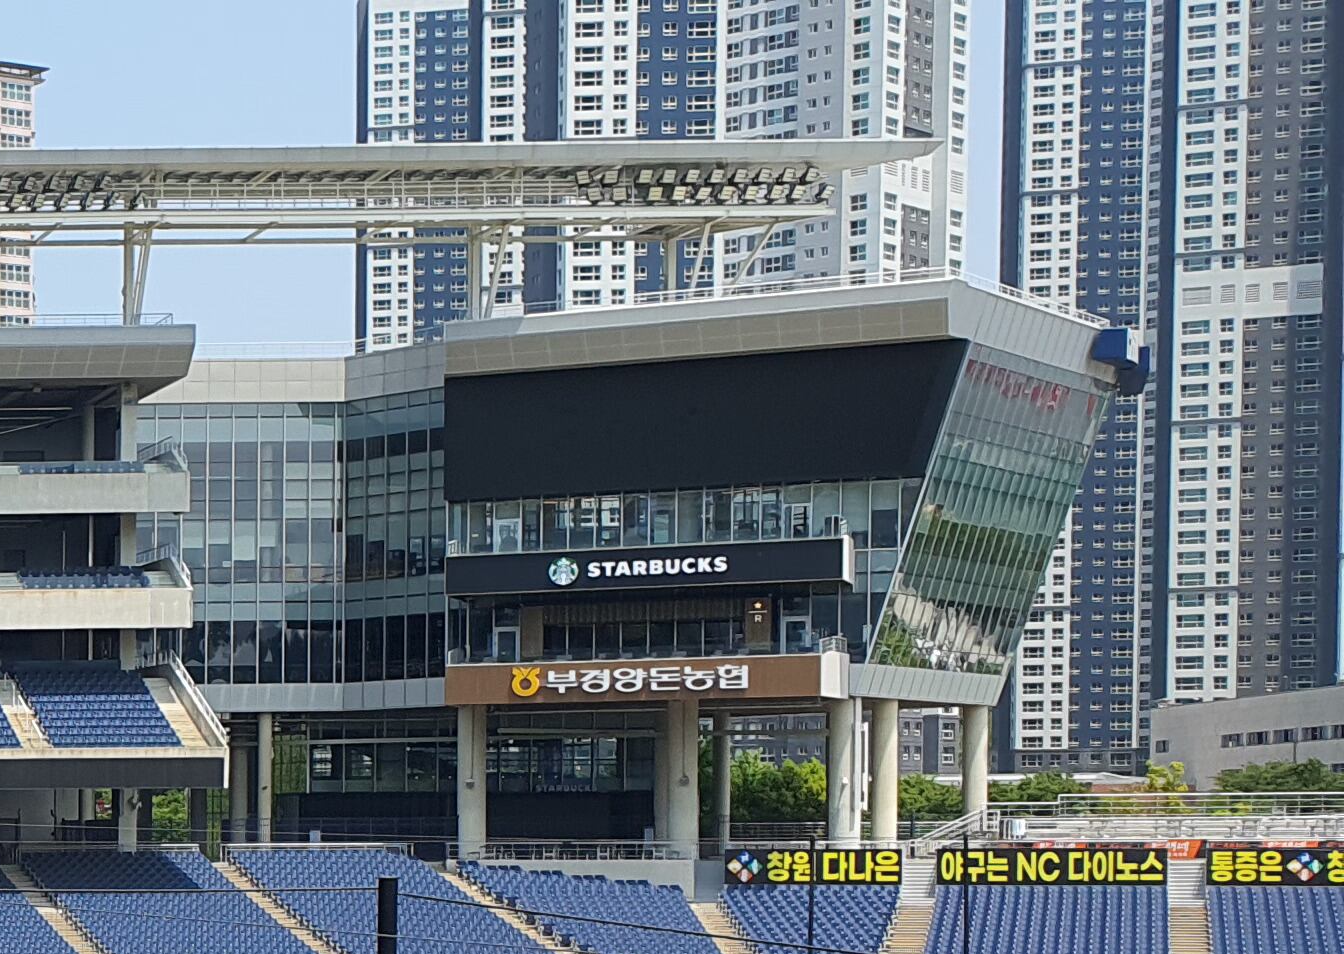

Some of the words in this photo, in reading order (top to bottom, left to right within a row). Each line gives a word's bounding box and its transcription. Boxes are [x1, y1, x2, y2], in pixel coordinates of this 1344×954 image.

[587, 556, 728, 578] STARBUCKS
[754, 614, 762, 623] R
[546, 664, 749, 694] 부경양돈농협
[767, 851, 810, 882] 창원
[823, 851, 900, 882] 다나은
[941, 851, 1009, 882] 야구는
[1016, 851, 1061, 882] NC
[1067, 850, 1164, 882] 다이노스
[1210, 850, 1283, 882] 통증은
